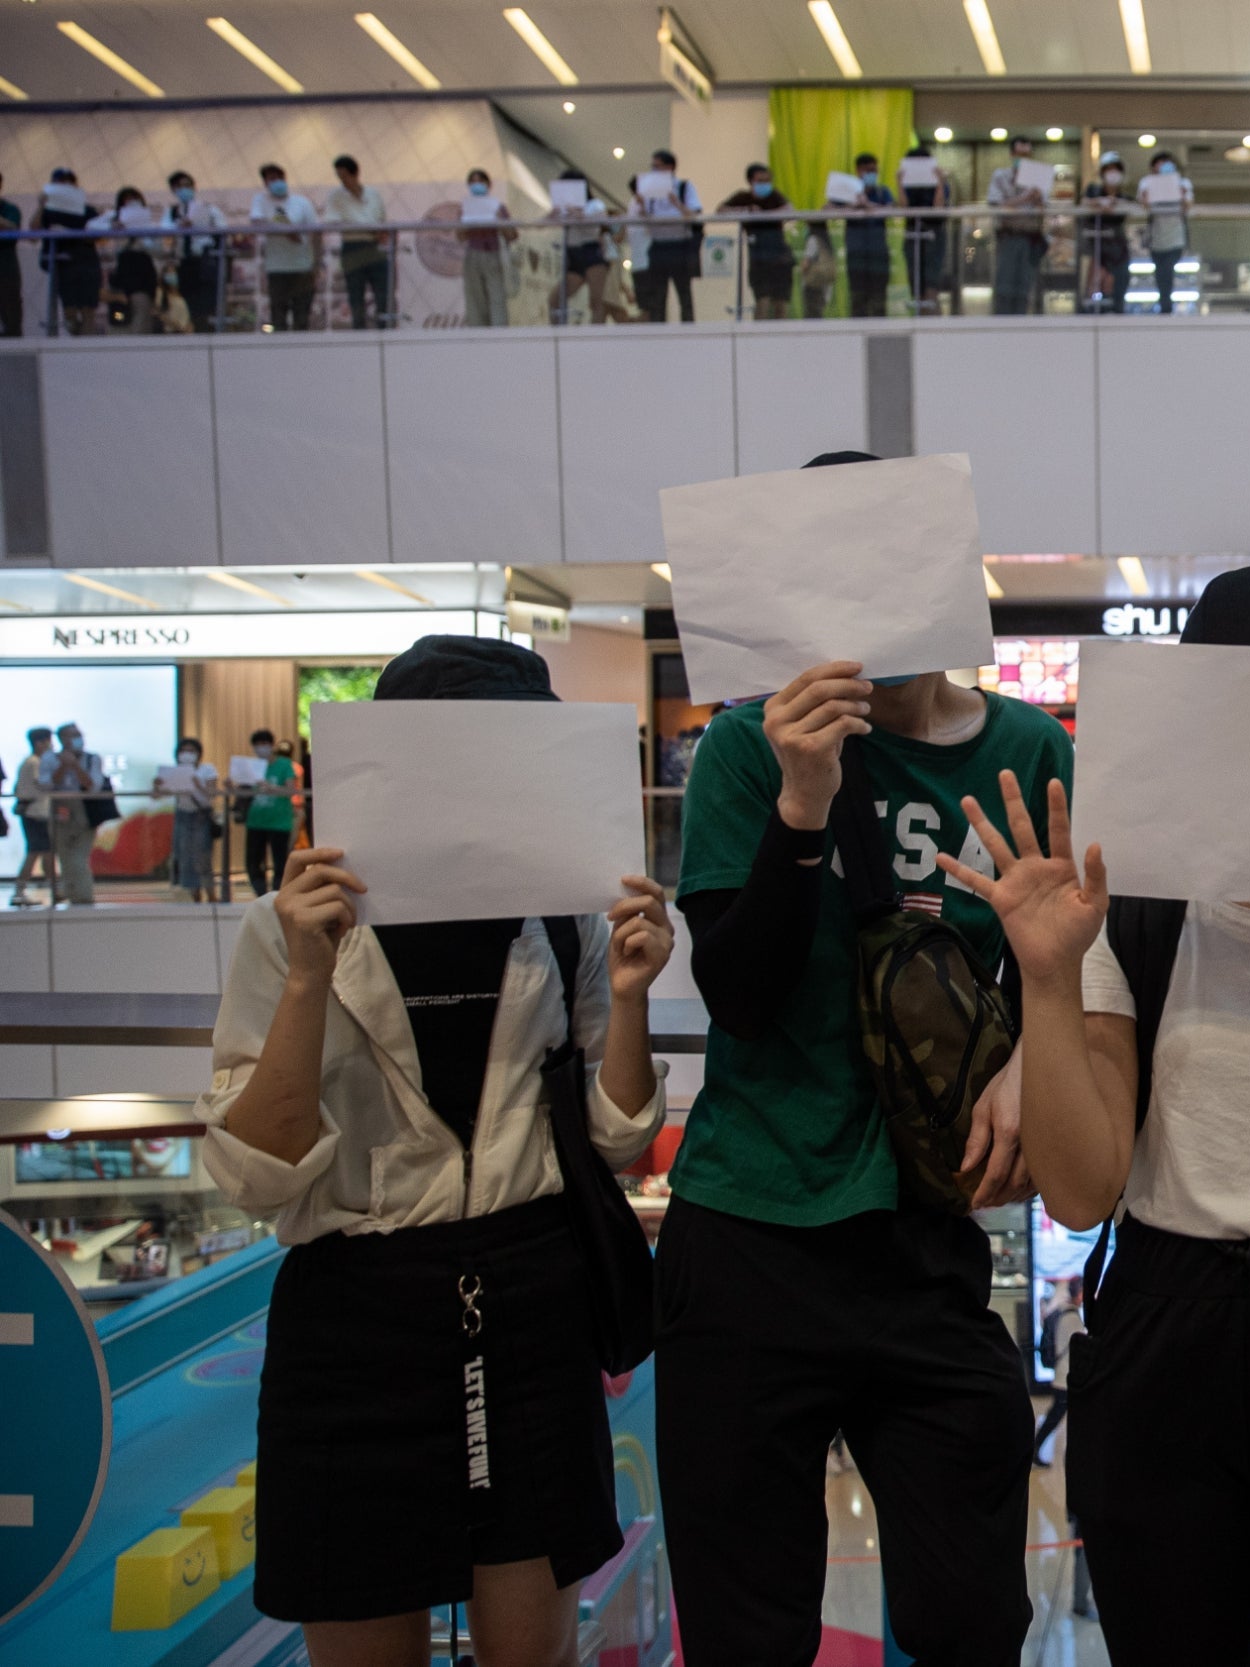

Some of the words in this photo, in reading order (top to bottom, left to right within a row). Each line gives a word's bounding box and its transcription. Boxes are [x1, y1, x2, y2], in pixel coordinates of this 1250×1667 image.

[1102, 603, 1171, 635] shu
[53, 626, 189, 648] NESPRESSO
[831, 800, 996, 901] SA
